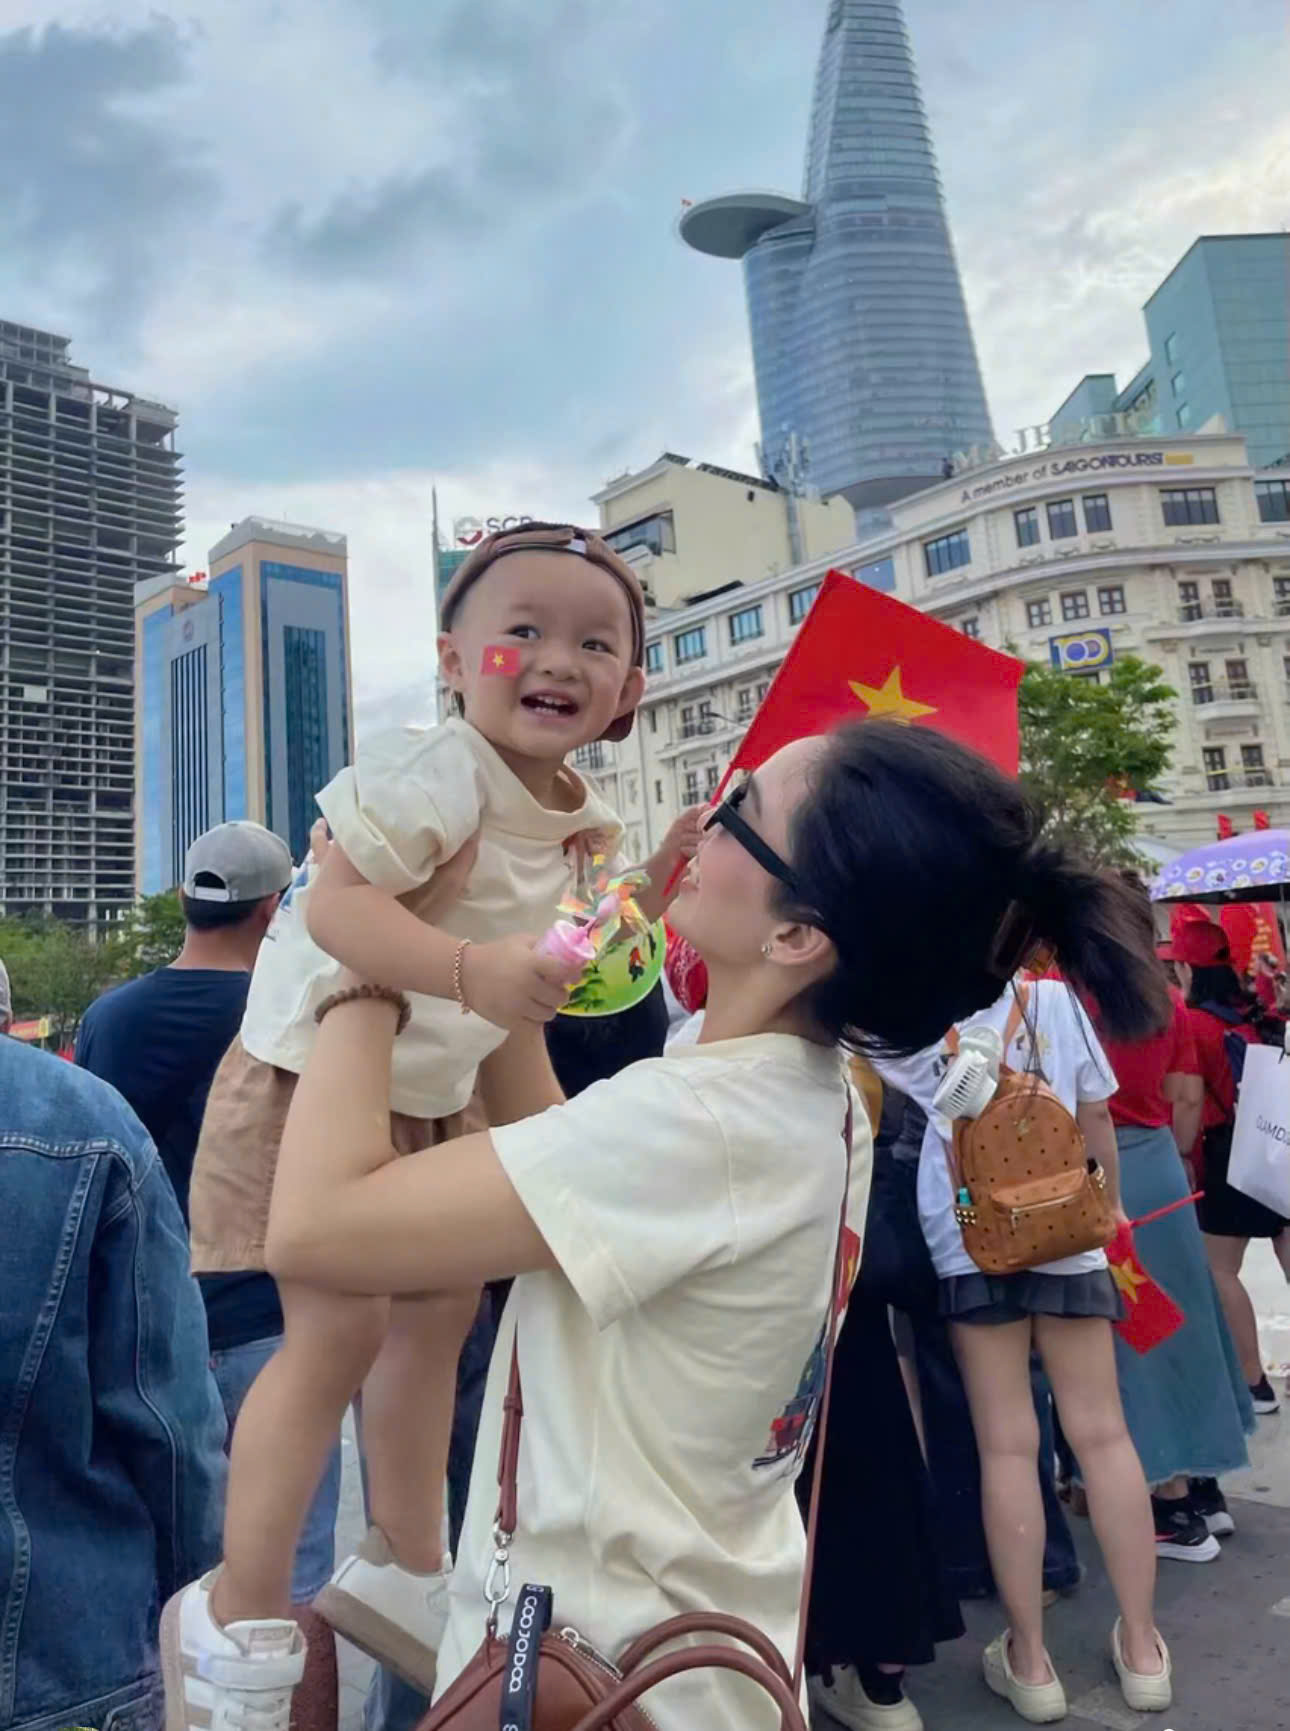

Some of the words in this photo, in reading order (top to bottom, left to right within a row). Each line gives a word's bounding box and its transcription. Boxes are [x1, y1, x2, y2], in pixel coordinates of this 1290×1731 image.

[961, 490, 972, 503] A
[973, 471, 1028, 499] member
[1033, 464, 1047, 481] of
